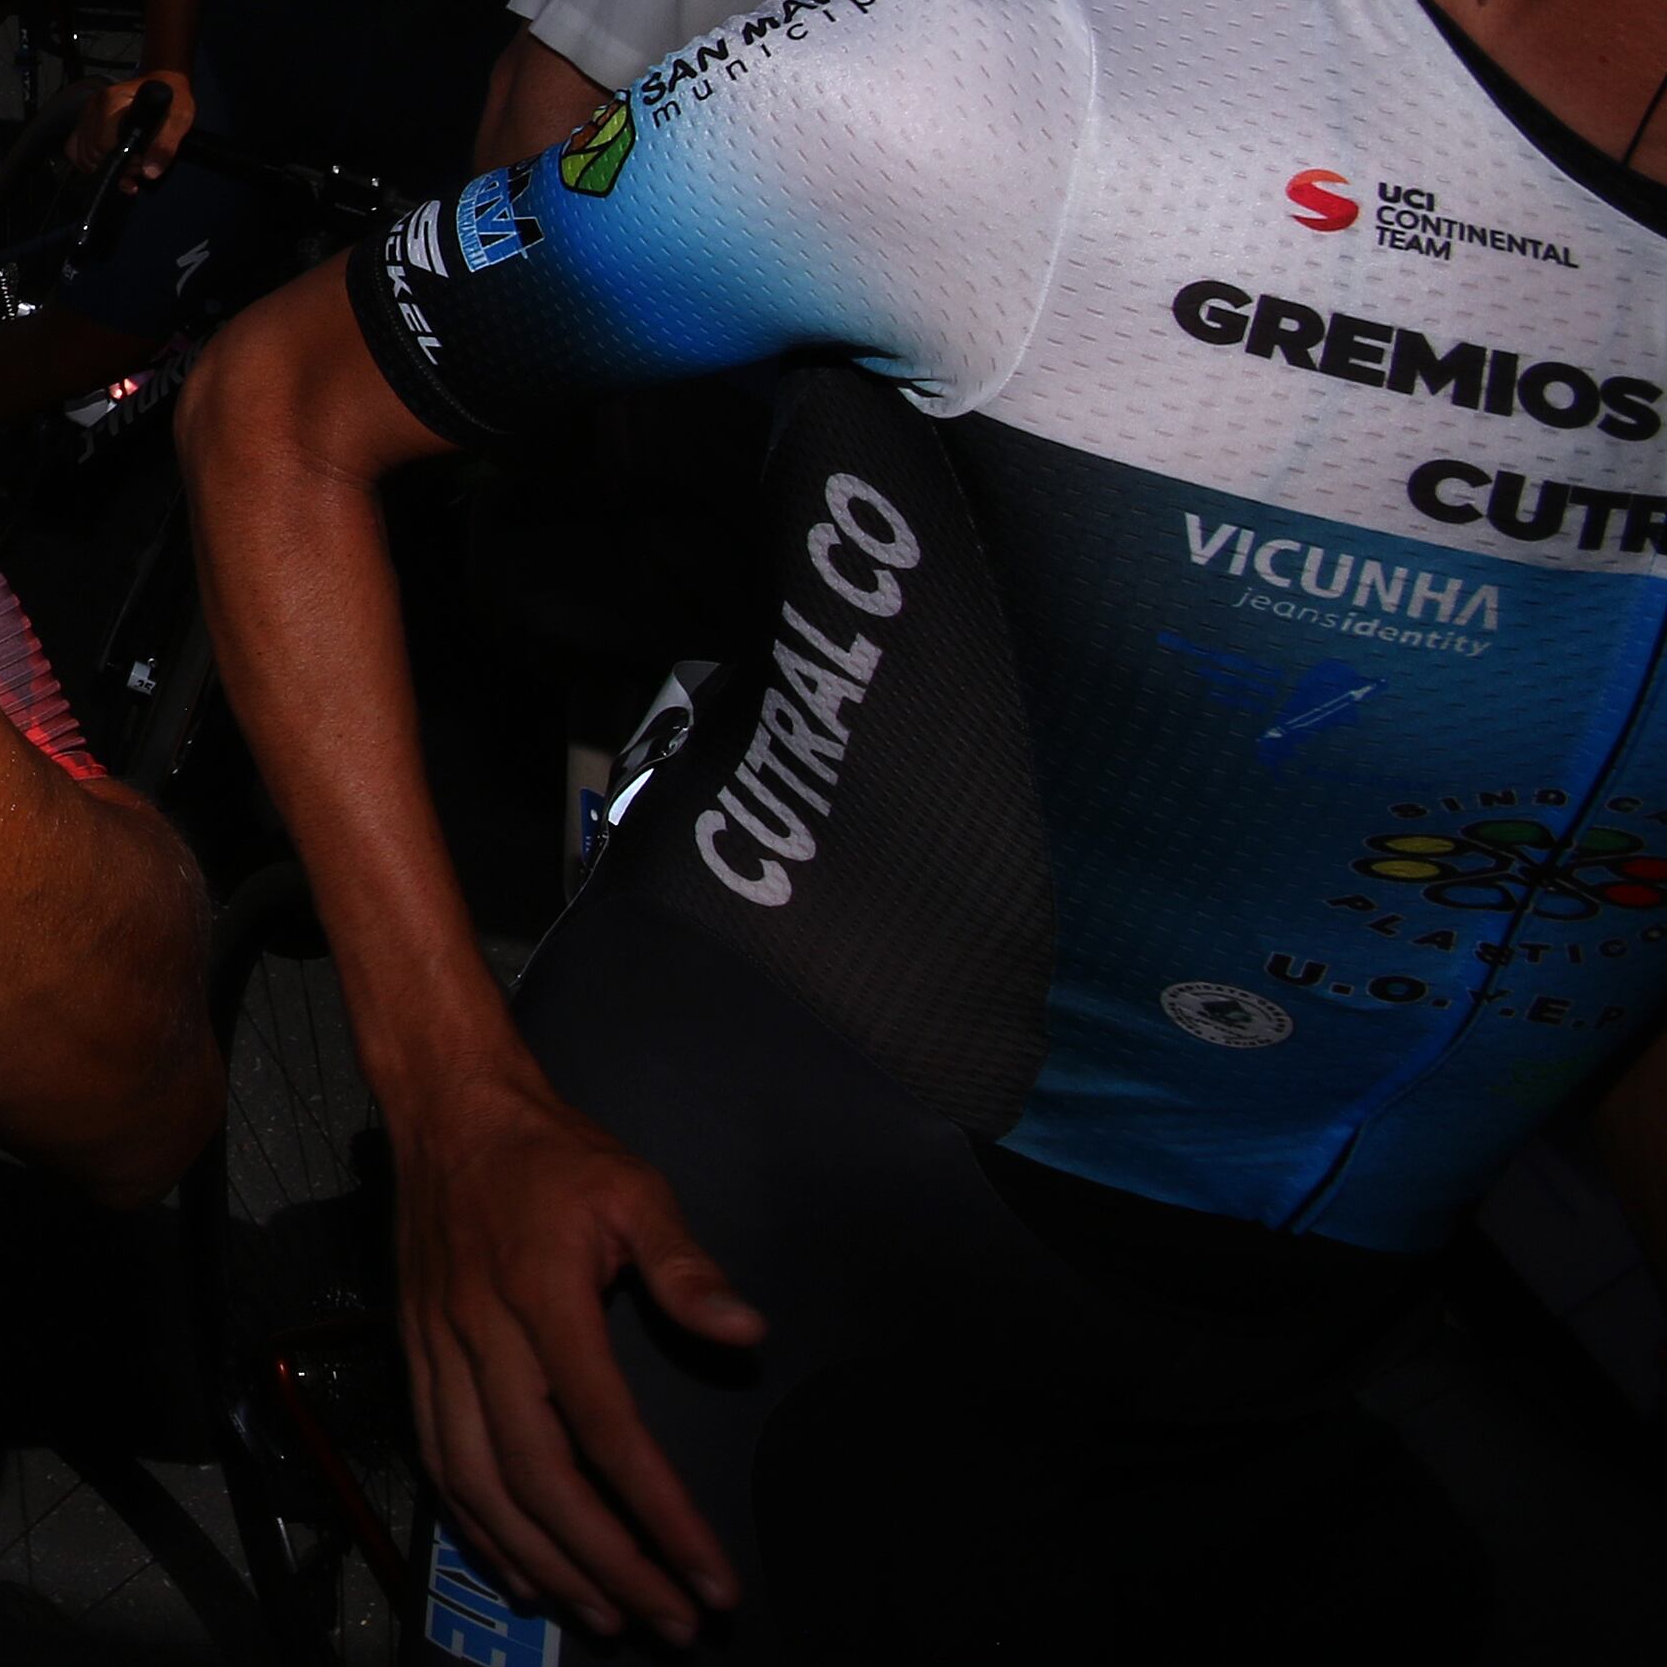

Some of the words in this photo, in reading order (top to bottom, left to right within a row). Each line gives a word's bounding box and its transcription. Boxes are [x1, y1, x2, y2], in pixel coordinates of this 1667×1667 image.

[641, 38, 730, 106] SAN
[1377, 181, 1436, 213] UCI
[1375, 206, 1580, 269] CONTINENTAL
[1375, 225, 1453, 262] TEAM
[1171, 279, 1665, 441] GREMIOS
[1185, 511, 1506, 632] VICUNHA
[694, 599, 883, 908] CUTRAL
[806, 471, 921, 618] CO
